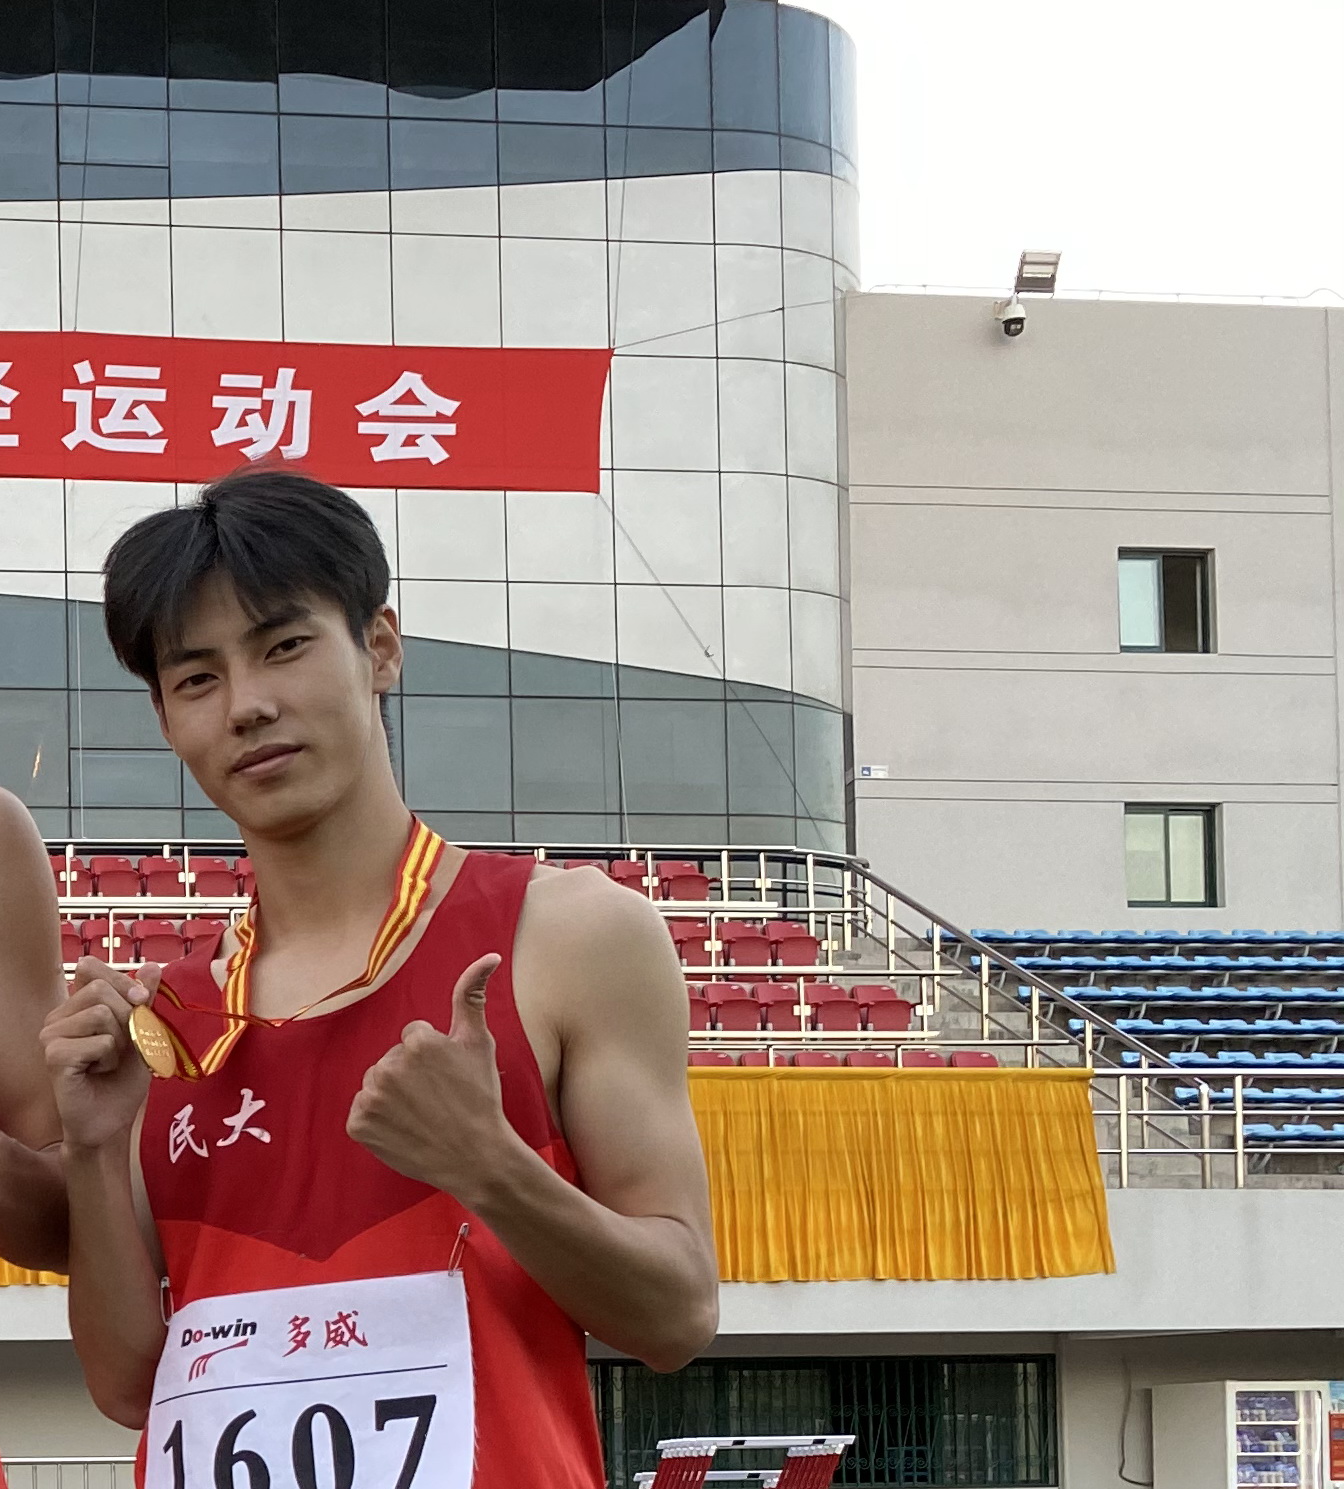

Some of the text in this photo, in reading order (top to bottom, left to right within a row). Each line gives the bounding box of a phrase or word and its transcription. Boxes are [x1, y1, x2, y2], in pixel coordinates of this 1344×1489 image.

[168, 1088, 272, 1164] 民大
[181, 1318, 257, 1347] Do-win
[283, 1310, 368, 1357] 多威
